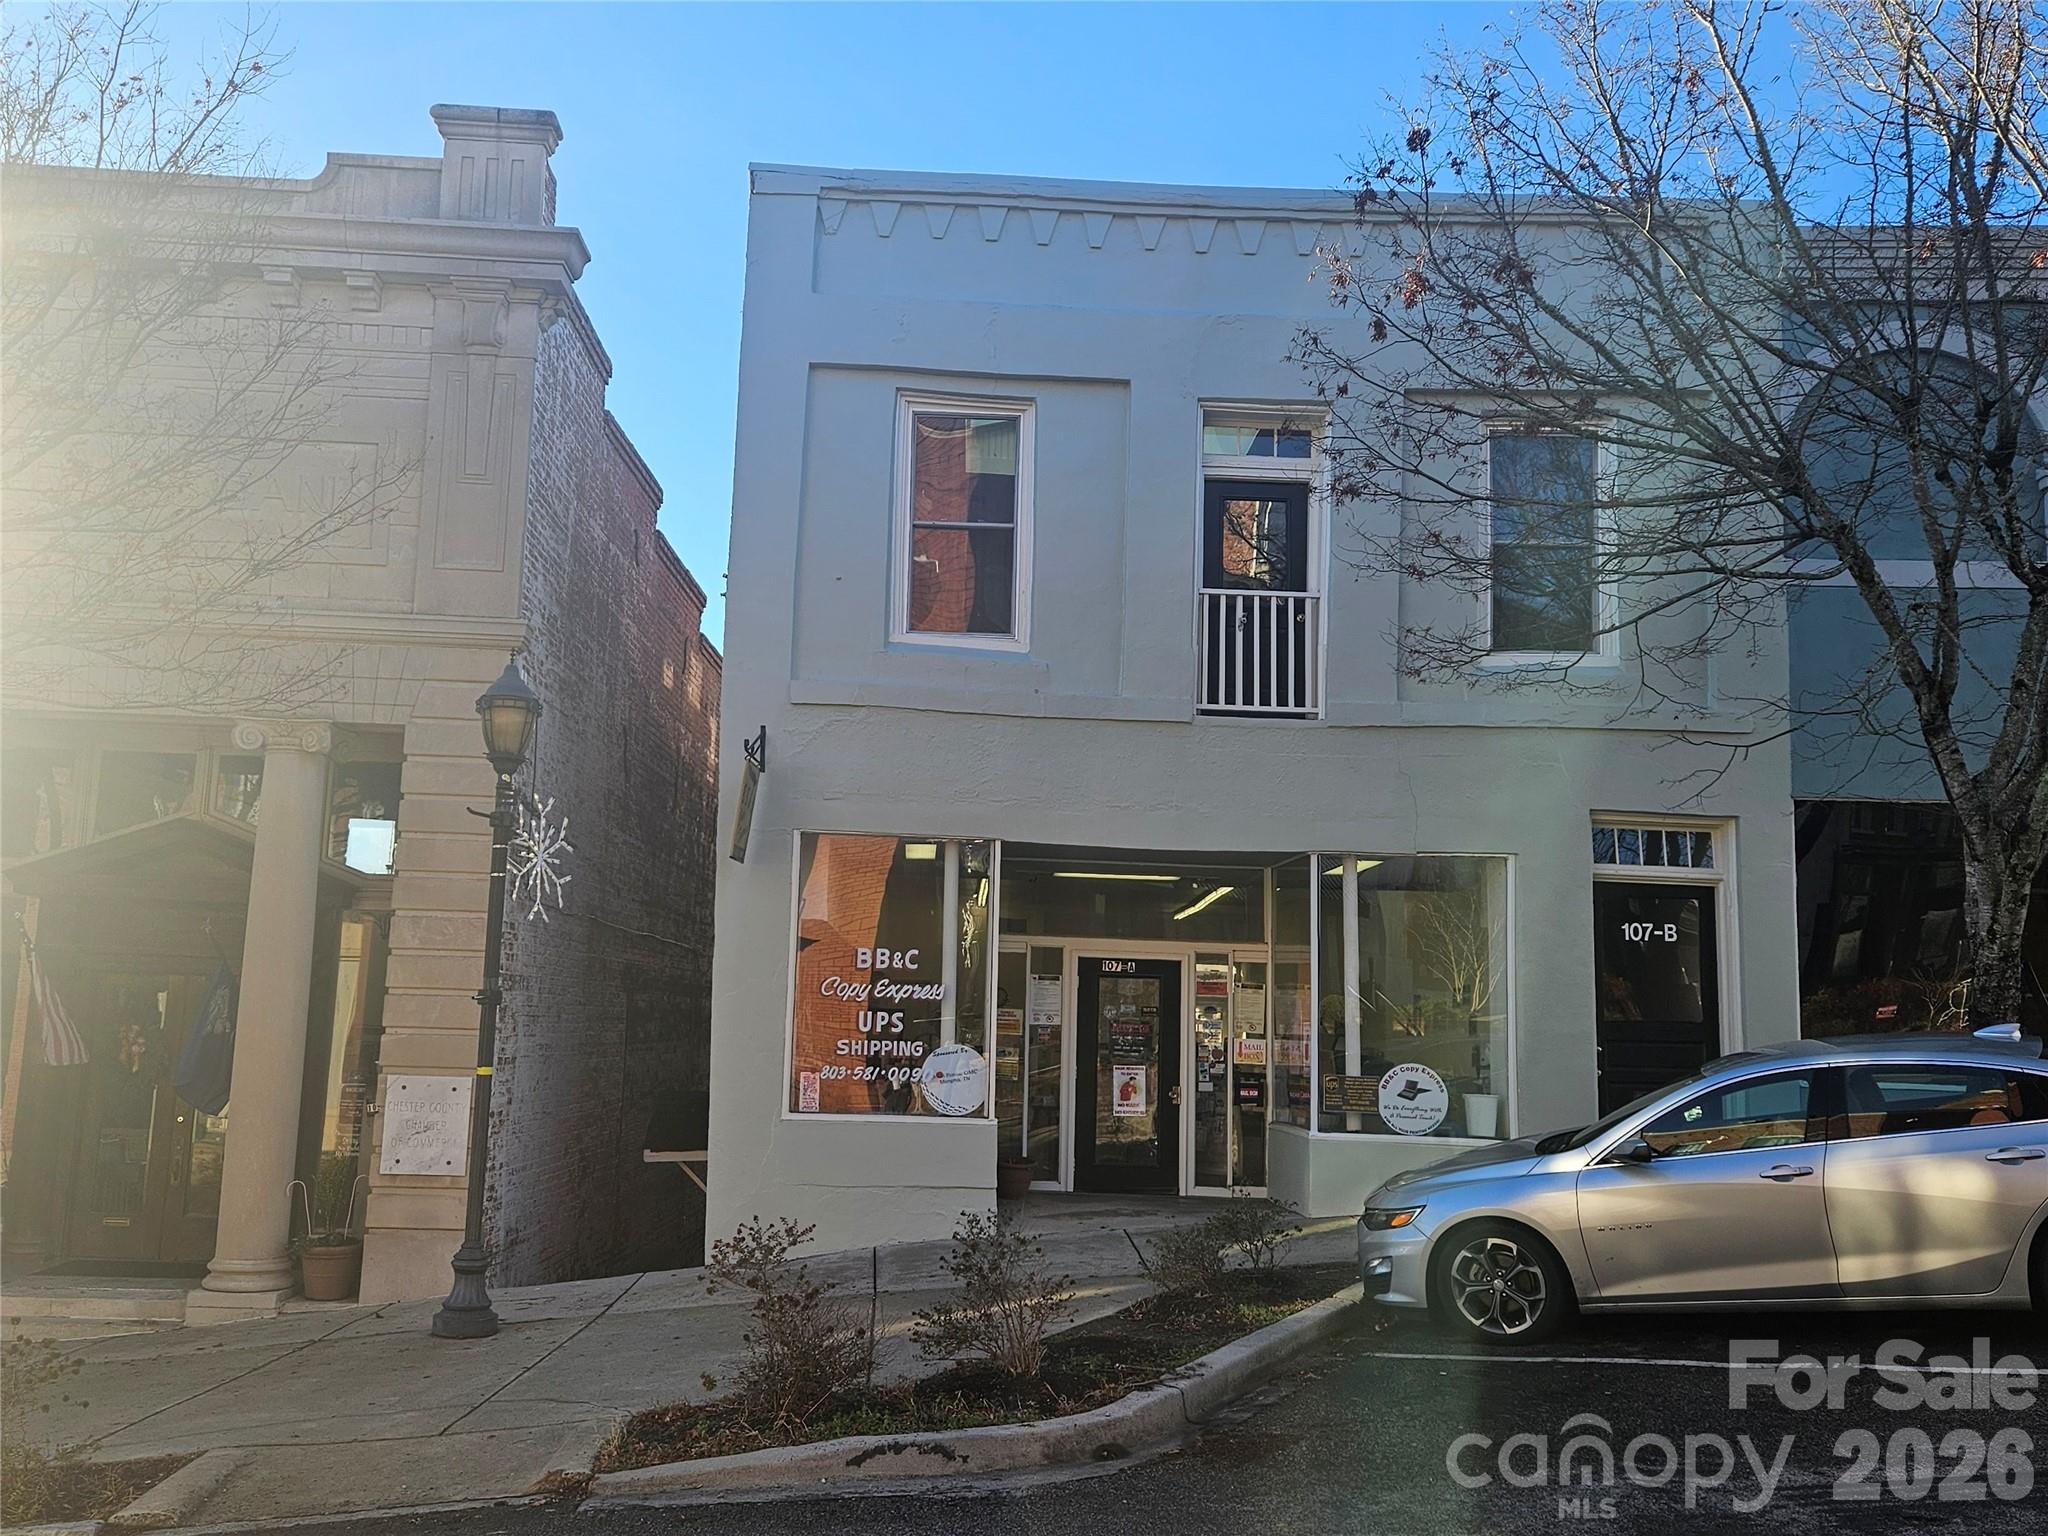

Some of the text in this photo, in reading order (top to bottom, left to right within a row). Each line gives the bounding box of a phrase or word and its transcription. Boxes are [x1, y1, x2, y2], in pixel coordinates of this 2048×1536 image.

[1621, 922, 1678, 942] 107-B
[856, 947, 919, 970] BB&C
[821, 976, 944, 1003] Copy Express
[858, 1010, 904, 1033] UPS
[836, 1039, 923, 1057] SHIPPING
[1244, 1043, 1264, 1051] MAIL
[1381, 1070, 1399, 1090] BB&C
[1421, 1067, 1445, 1093] Express
[388, 1100, 467, 1114] CHESTER COUNTY
[405, 1119, 447, 1131] CHAMBER
